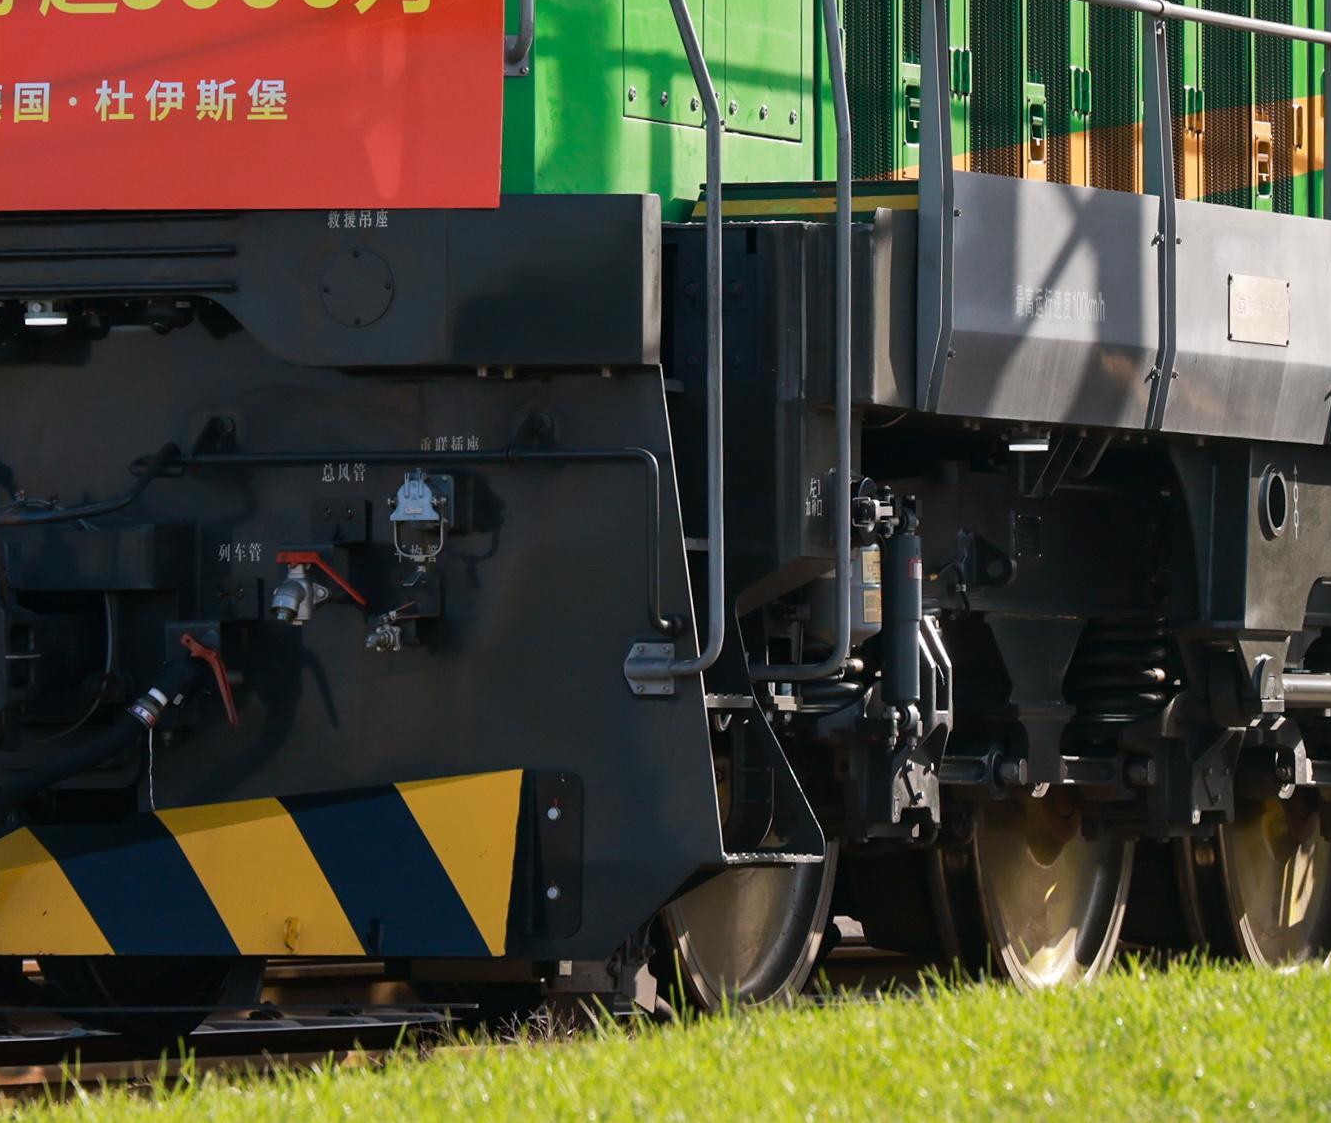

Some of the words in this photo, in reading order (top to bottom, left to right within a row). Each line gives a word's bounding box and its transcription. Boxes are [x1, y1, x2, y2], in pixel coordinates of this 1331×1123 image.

[327, 209, 388, 229] 救援吊座
[321, 463, 367, 482] 总风管
[218, 542, 262, 563] 列车管
